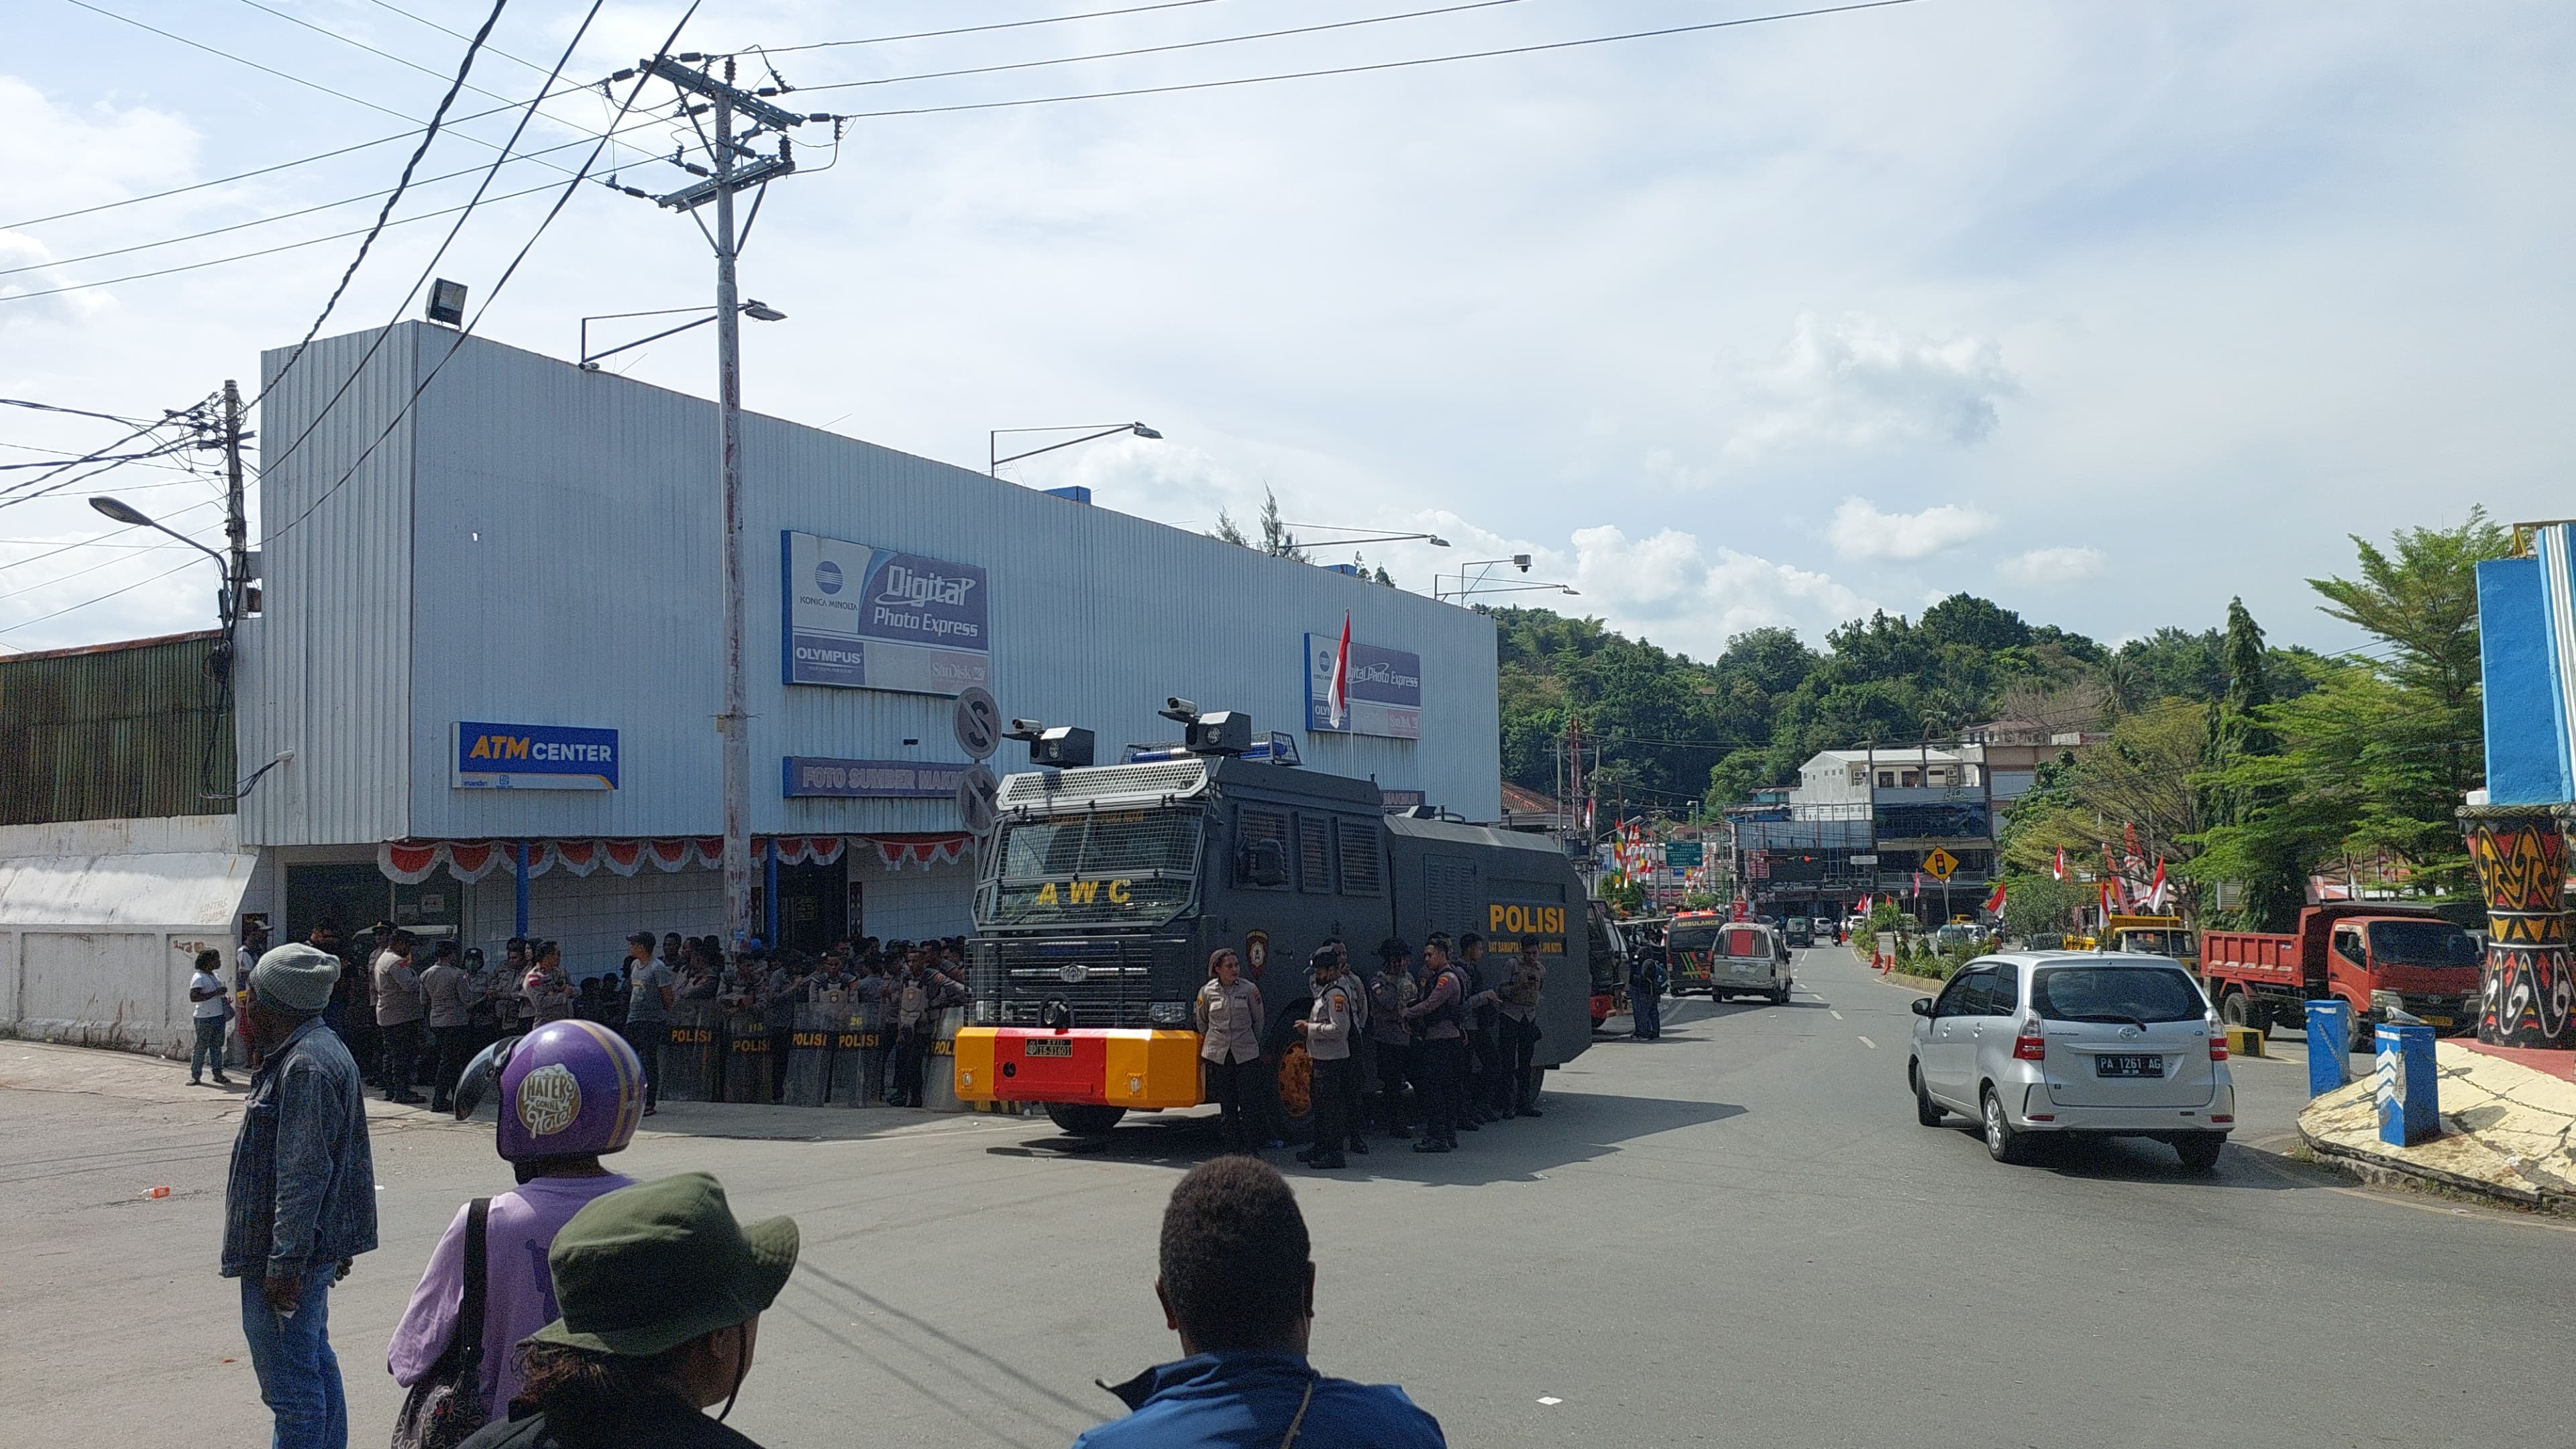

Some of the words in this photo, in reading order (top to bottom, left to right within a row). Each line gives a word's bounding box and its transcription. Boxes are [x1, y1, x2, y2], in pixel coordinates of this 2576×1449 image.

[883, 565, 975, 608] Digital
[800, 596, 827, 607] KONICA
[829, 600, 858, 611] MINOLTA
[873, 605, 919, 629] Photo
[922, 613, 978, 637] Express
[796, 647, 861, 664] OLYMPUS
[932, 661, 971, 680] SanDisk
[1348, 665, 1366, 682] gital
[1368, 666, 1389, 683] Photo
[1391, 671, 1418, 689] Express
[470, 735, 530, 759] ATM
[532, 743, 612, 762] CENTER
[803, 766, 847, 788] FOTO
[849, 767, 915, 790] SUMBER
[1489, 904, 1565, 933] POLISI
[1677, 920, 1720, 928] AMBULANCE
[672, 1029, 712, 1042] POLISI
[793, 1032, 827, 1046] POLISI
[839, 1034, 880, 1047] POLISI
[733, 1039, 770, 1052] POLISI
[2100, 1058, 2114, 1069] PA
[2119, 1058, 2141, 1069] 1261
[2149, 1058, 2161, 1069] AG
[527, 1075, 574, 1099] HATERS
